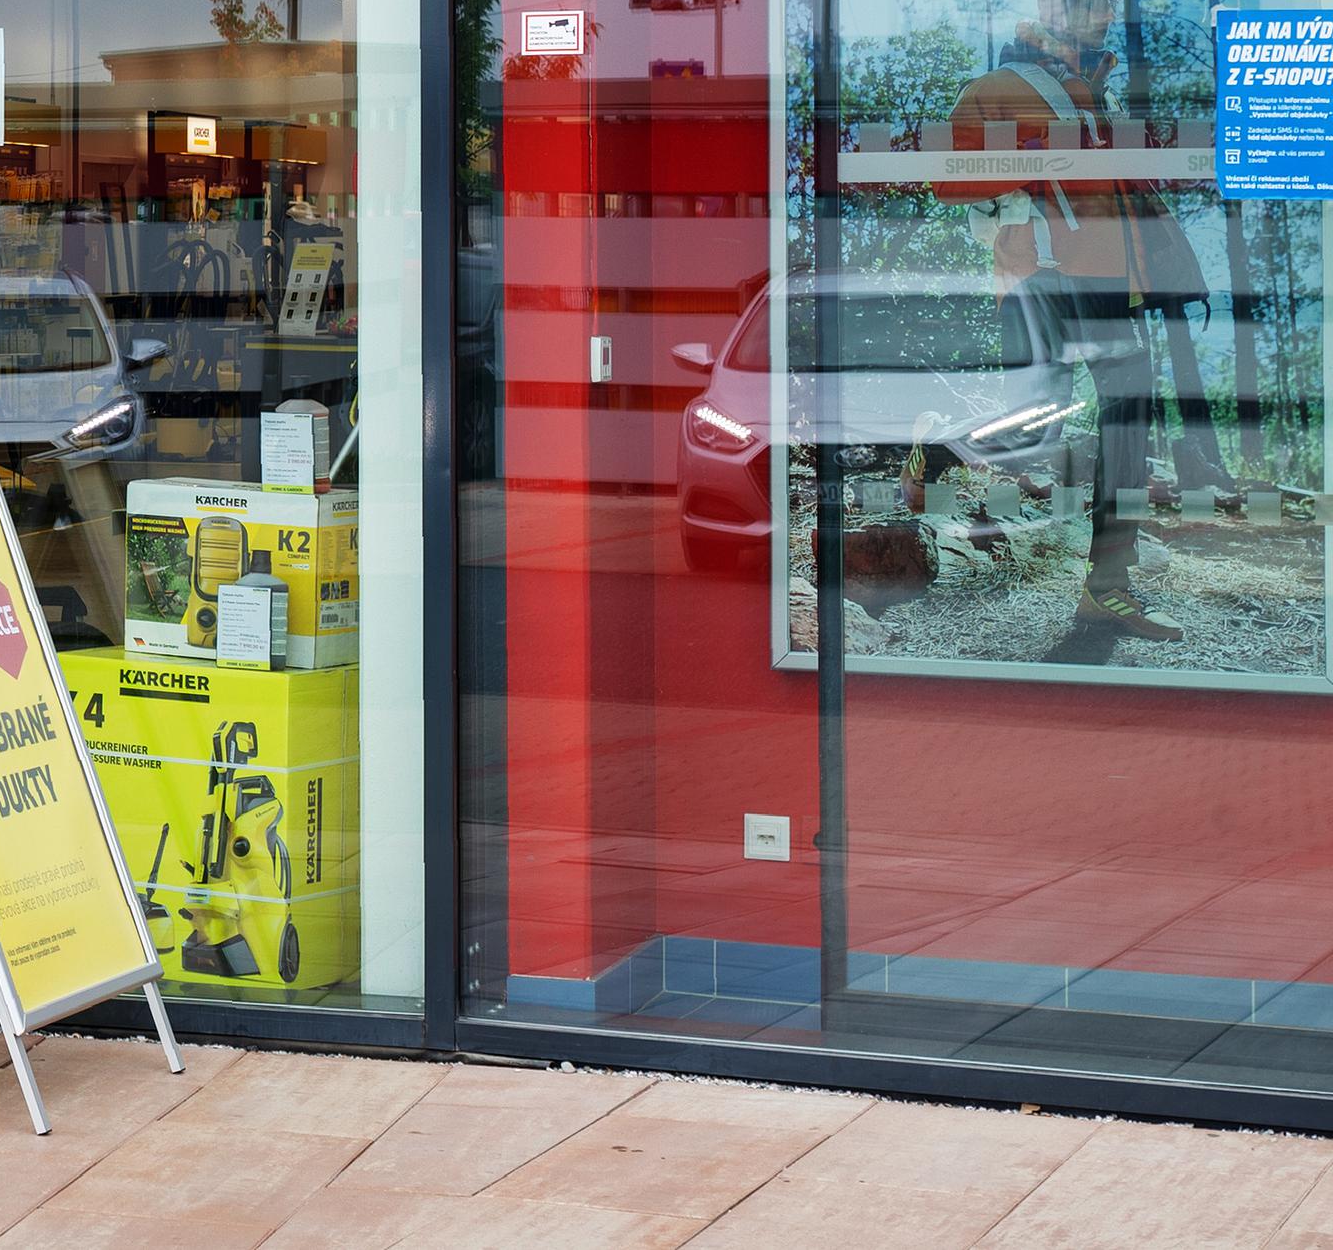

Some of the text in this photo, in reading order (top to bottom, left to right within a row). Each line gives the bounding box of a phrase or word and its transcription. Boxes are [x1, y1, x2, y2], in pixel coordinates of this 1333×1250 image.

[1226, 16, 1333, 40] JAK NA VÝD
[1226, 67, 1333, 86] Z E-SHOPU?
[945, 157, 1044, 174] SPORTISIMO
[195, 495, 248, 508] KÄRCHER
[120, 669, 210, 691] KÄRCHER
[83, 693, 105, 728] 4
[85, 739, 148, 755] RUCKREINIGER
[90, 753, 162, 770] ESSURE WASHER
[306, 779, 316, 884] KÄRCHER
[0, 880, 12, 896] naší
[13, 871, 42, 893] prodejně
[60, 860, 85, 879] probíhá
[21, 897, 36, 913] akce
[36, 895, 45, 908] na
[46, 886, 71, 906] vybrané
